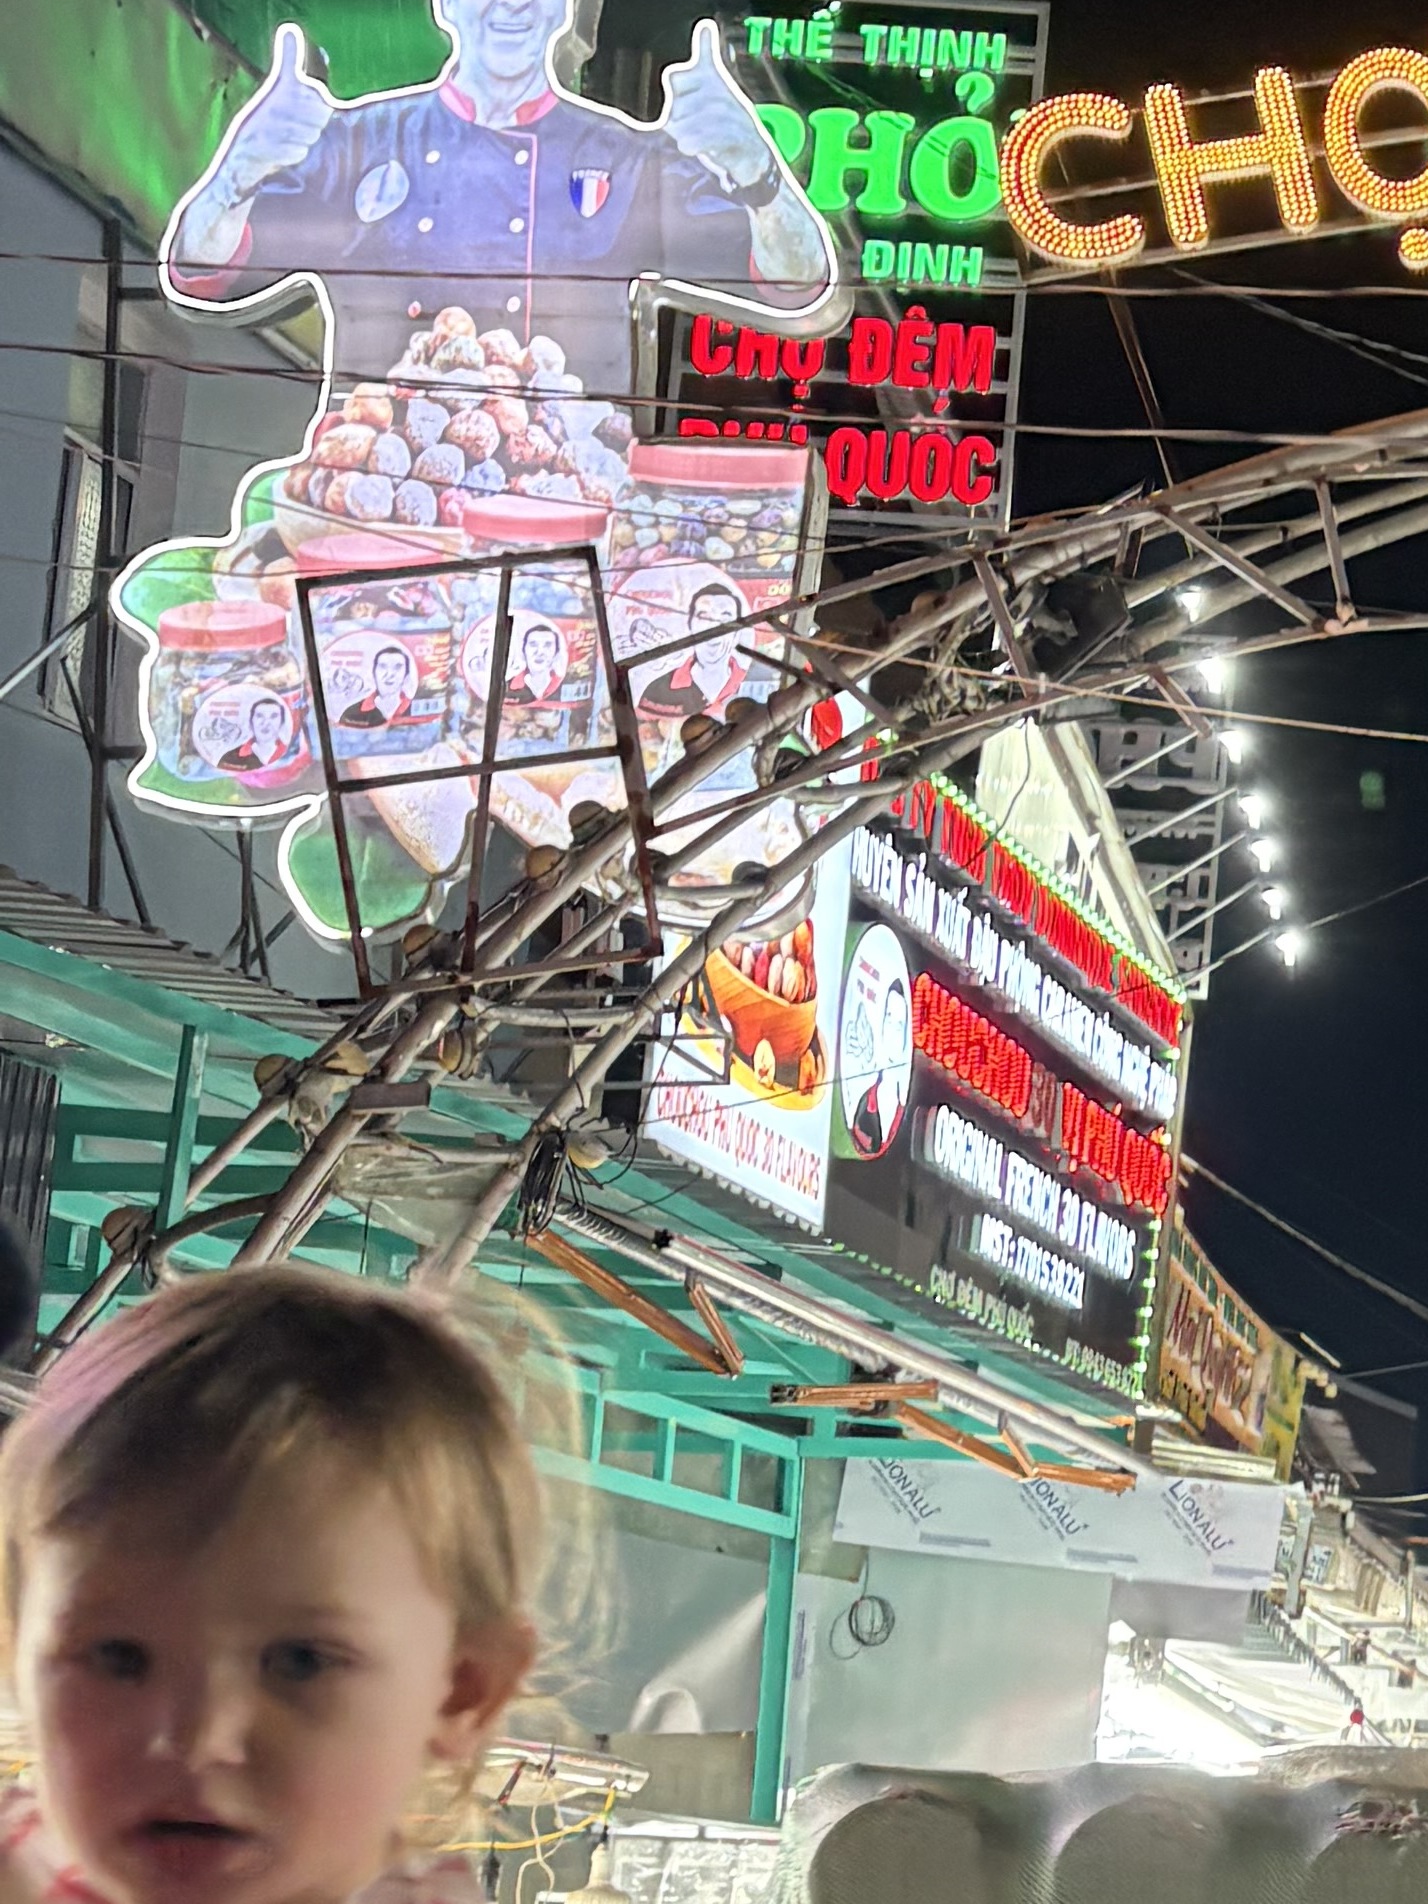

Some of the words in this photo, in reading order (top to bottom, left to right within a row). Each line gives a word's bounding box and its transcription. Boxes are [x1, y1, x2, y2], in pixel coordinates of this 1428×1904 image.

[743, 0, 841, 62] THẾ
[861, 22, 1007, 80] THỊNH
[847, 305, 996, 394] ĐÊM
[824, 397, 999, 506] QUỐC
[934, 1104, 1004, 1201] ORIGINAL
[1004, 1150, 1061, 1236] FRENCH
